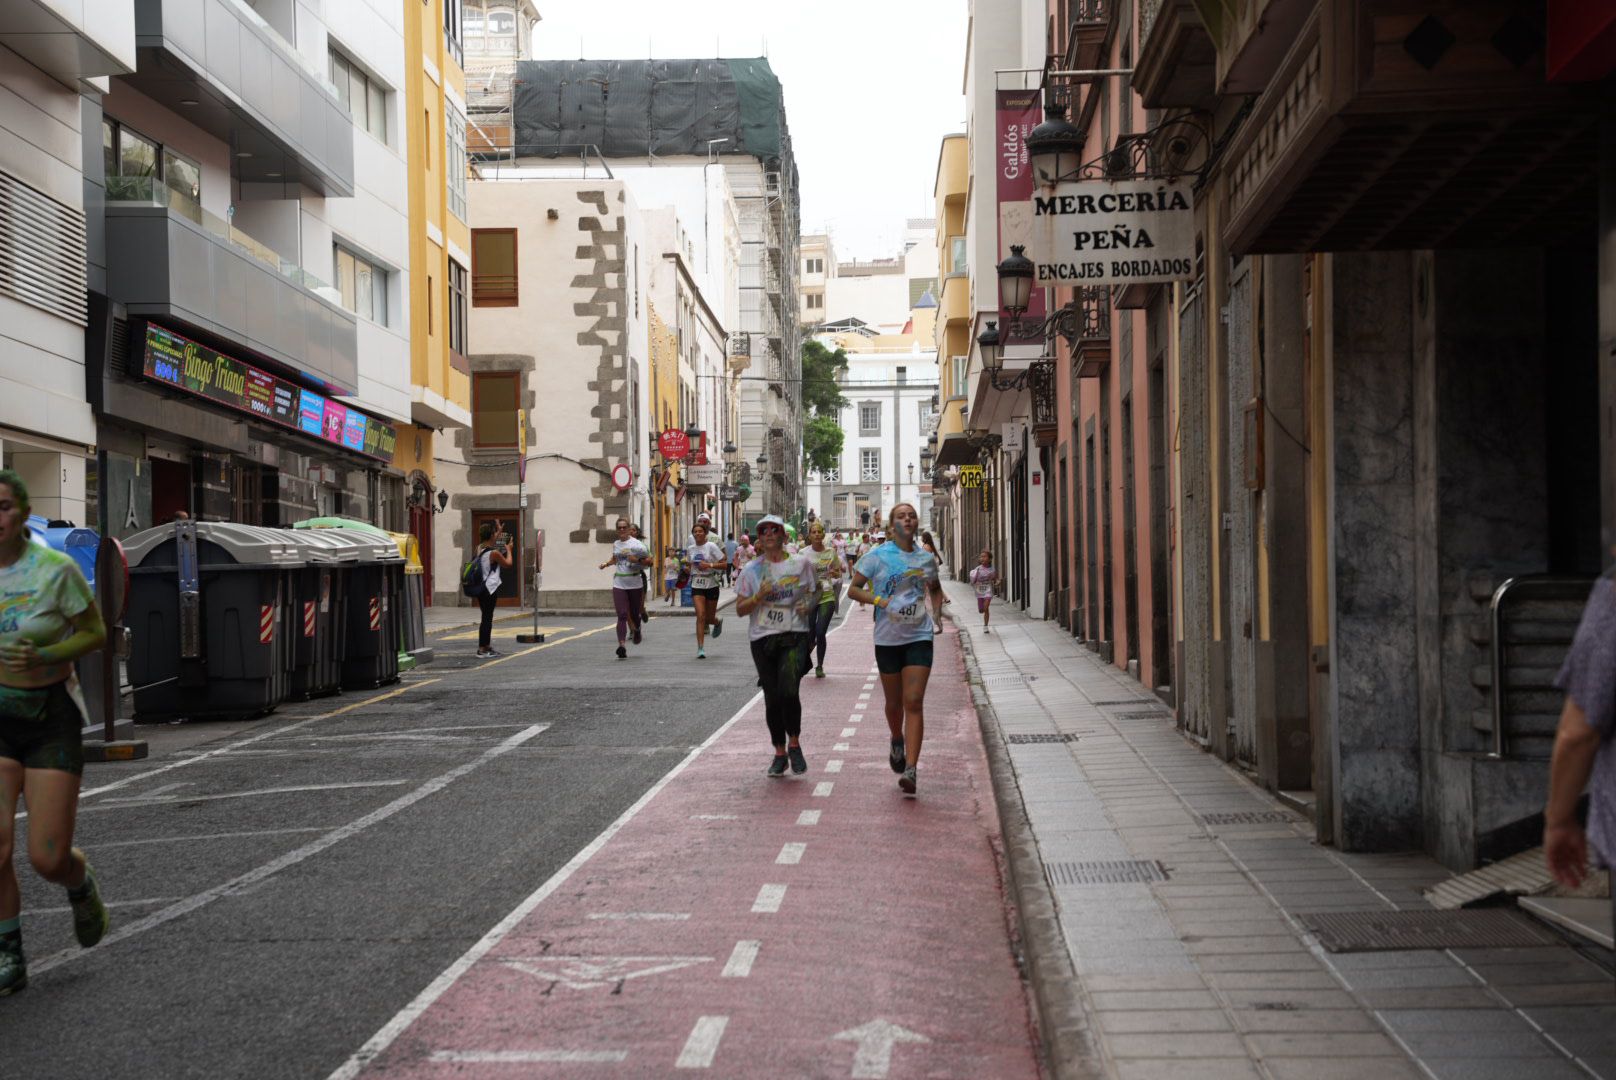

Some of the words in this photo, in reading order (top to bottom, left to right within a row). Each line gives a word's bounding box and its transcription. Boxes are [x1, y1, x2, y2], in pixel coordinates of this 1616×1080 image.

[1003, 124, 1019, 180] Galdós
[1034, 186, 1190, 216] MERCERÍA
[1073, 224, 1155, 251] PEÑA
[1038, 262, 1104, 281] ENCAJES
[1111, 258, 1192, 278] BORDADOS
[184, 343, 214, 393] Bingo
[214, 356, 246, 396] Triana
[365, 418, 380, 455] Bingo
[379, 425, 396, 454] Triana
[961, 471, 982, 487] ORO
[767, 609, 784, 623] 478
[898, 604, 917, 617] 487
